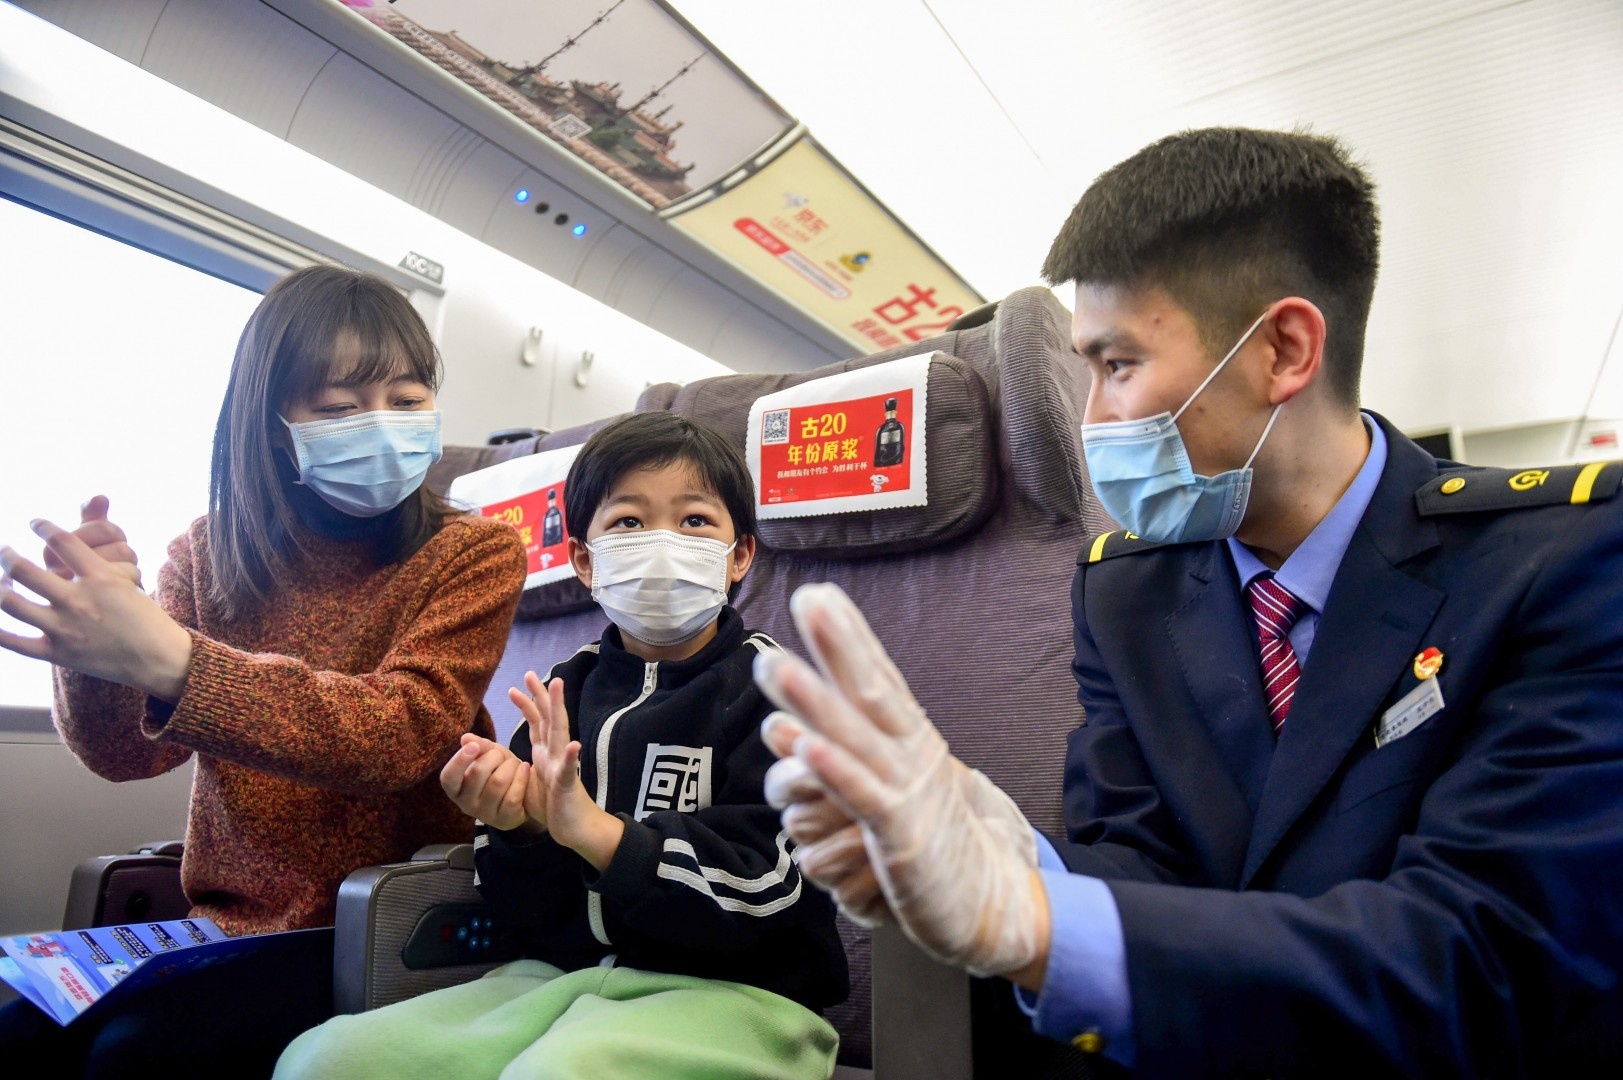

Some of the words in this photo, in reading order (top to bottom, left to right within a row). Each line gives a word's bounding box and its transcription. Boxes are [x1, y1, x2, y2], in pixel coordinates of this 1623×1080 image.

[800, 412, 847, 440] 古20
[787, 438, 859, 466] 年份原浆
[776, 466, 829, 480] 我和朋友有个约会
[832, 461, 869, 474] 为胜利干杯
